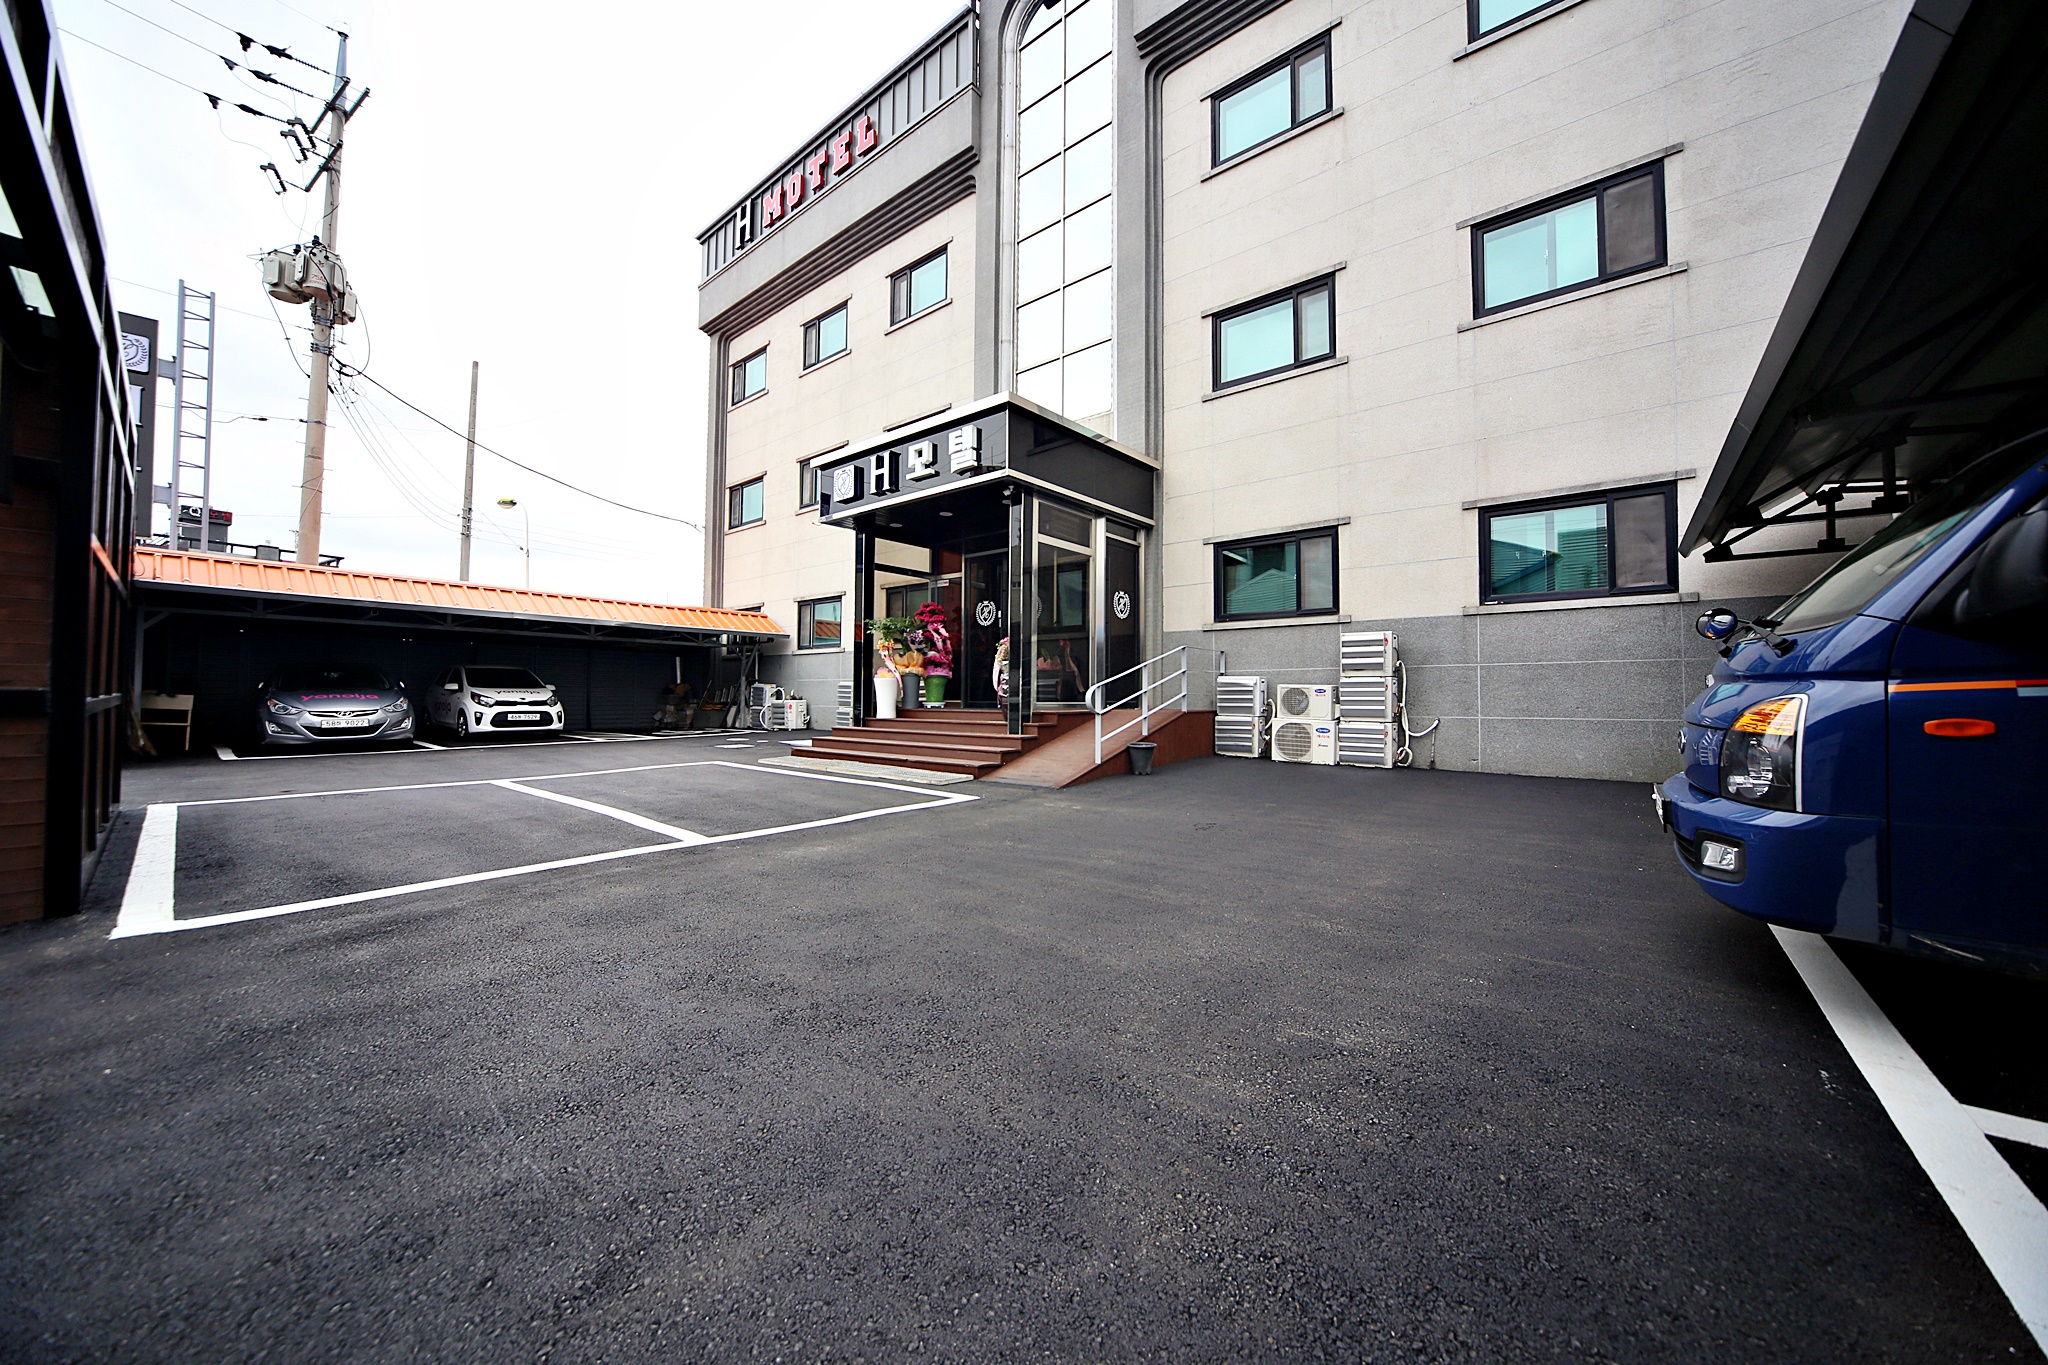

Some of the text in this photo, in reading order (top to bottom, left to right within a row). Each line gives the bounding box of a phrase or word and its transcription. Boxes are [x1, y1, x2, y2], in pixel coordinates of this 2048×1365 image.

[735, 115, 877, 249] H MOTEL
[301, 693, 379, 702] yanolja
